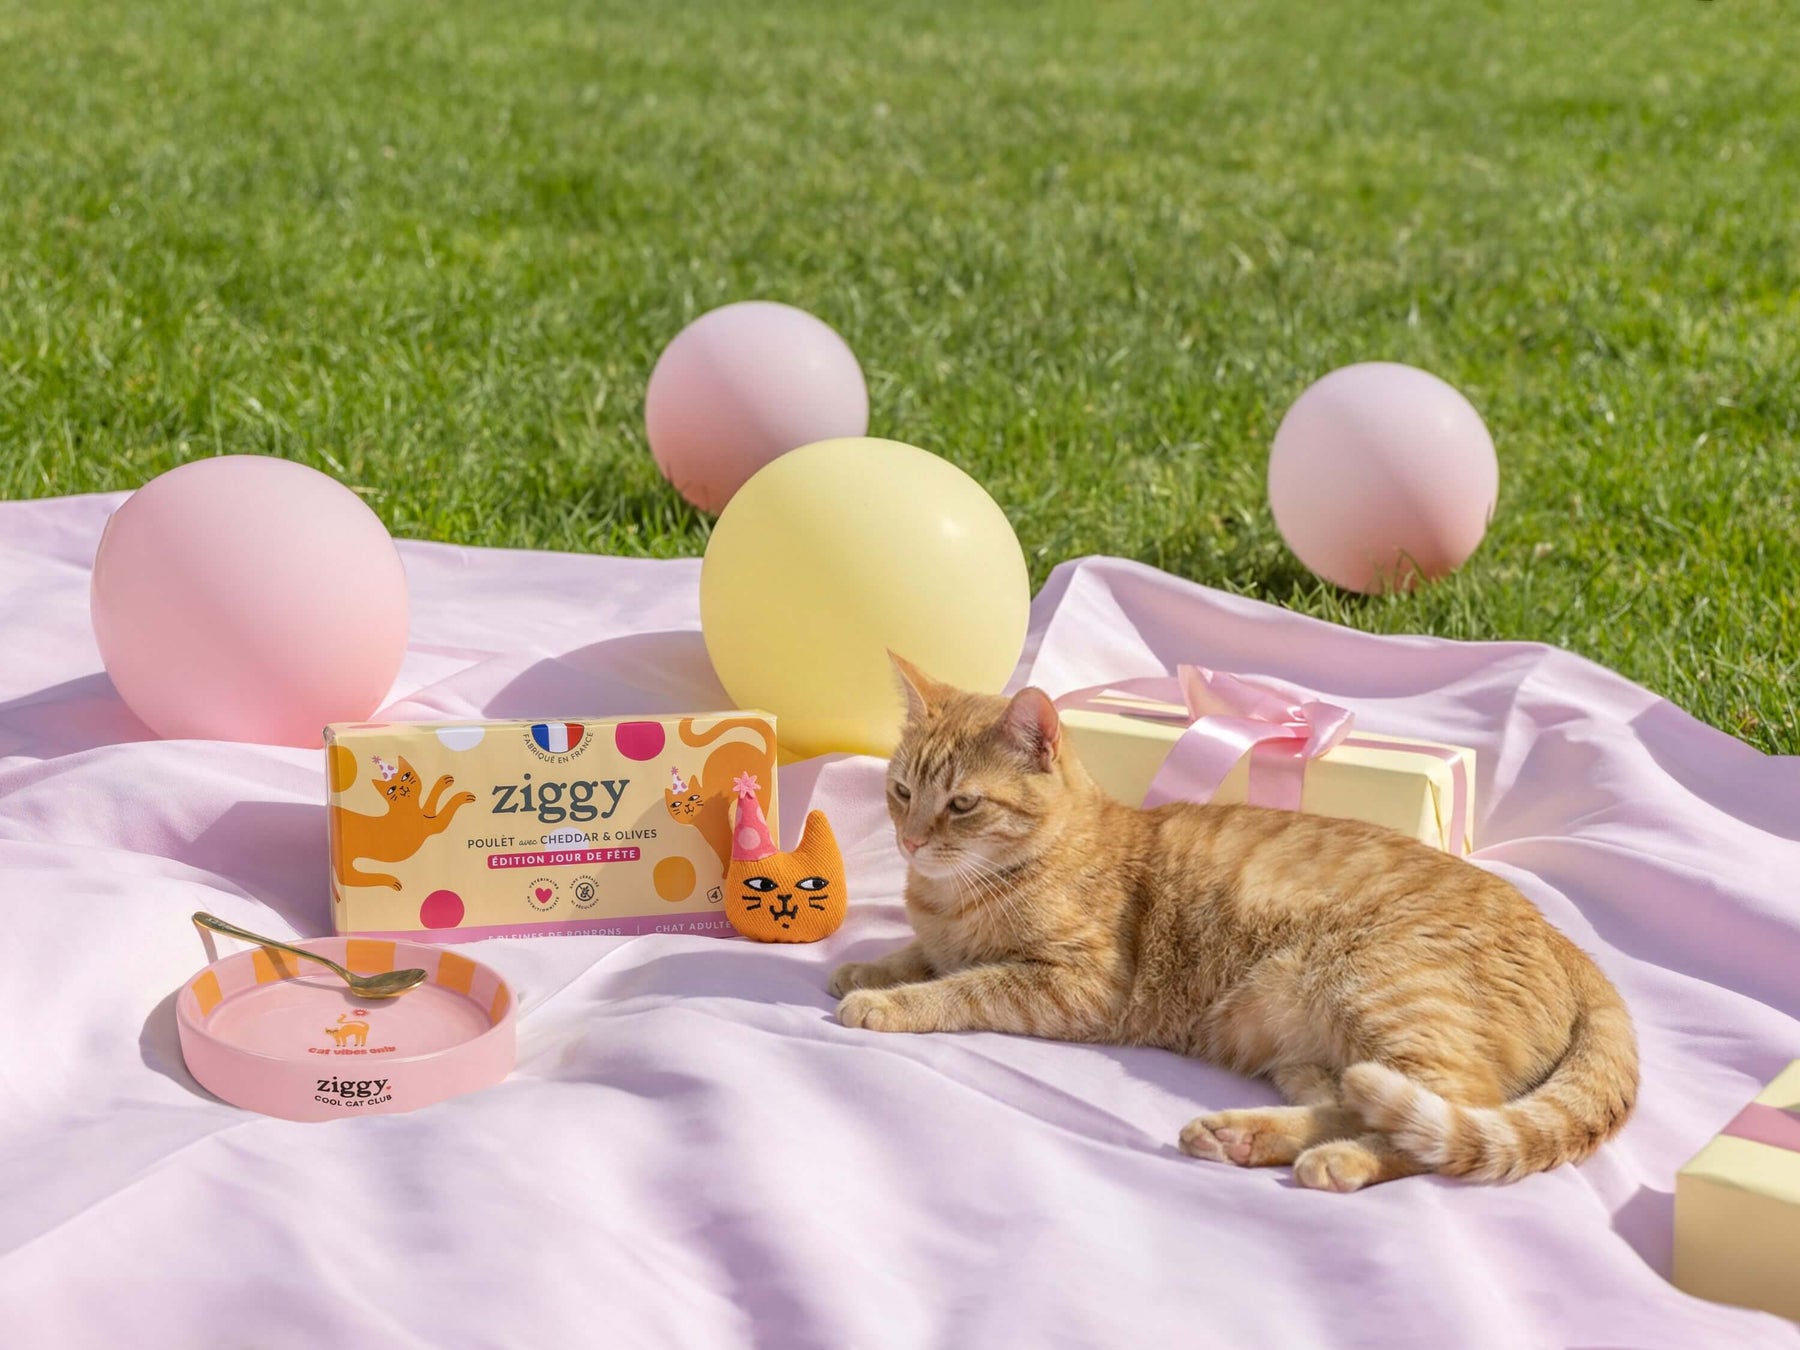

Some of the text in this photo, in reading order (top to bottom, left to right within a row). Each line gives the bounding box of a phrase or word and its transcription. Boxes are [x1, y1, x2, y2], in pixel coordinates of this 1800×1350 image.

[557, 756, 569, 764] EN
[570, 732, 594, 760] FRANCE
[491, 773, 630, 823] ziggy
[518, 839, 538, 847] avec
[540, 832, 599, 845] CHEDDAR
[602, 831, 612, 841] &
[615, 829, 657, 841] OLIVES
[492, 849, 636, 867] ÉDITION JOUR DE FÊTE
[711, 890, 719, 899] 4
[655, 923, 685, 933] CHAT
[307, 1046, 396, 1056] cat vibes only
[316, 1076, 389, 1099] ziggy
[314, 1094, 392, 1108] COOL CAT CLUB
